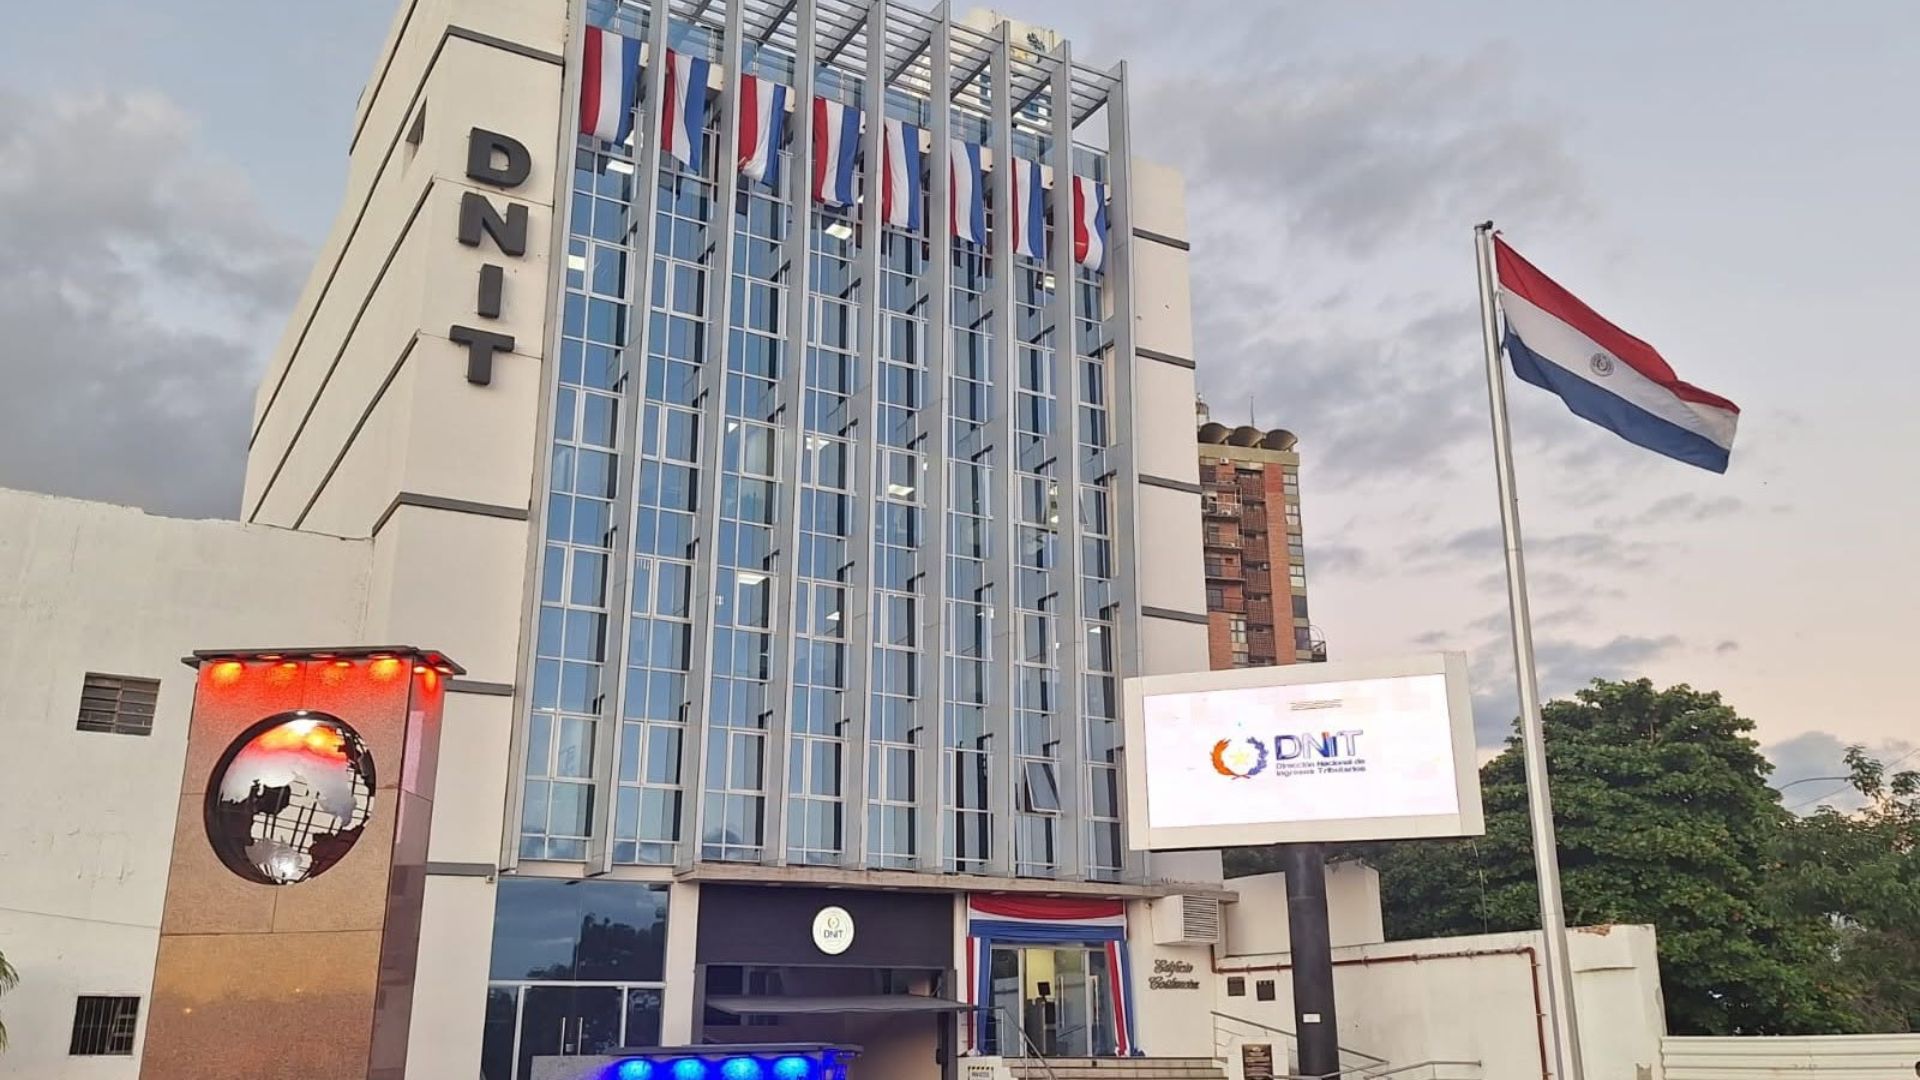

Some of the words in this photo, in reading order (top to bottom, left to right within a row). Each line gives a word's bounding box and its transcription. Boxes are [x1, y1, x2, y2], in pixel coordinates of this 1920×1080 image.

[450, 127, 532, 386] DNIT
[1274, 730, 1363, 760] DNIT
[824, 930, 843, 938] DNIT
